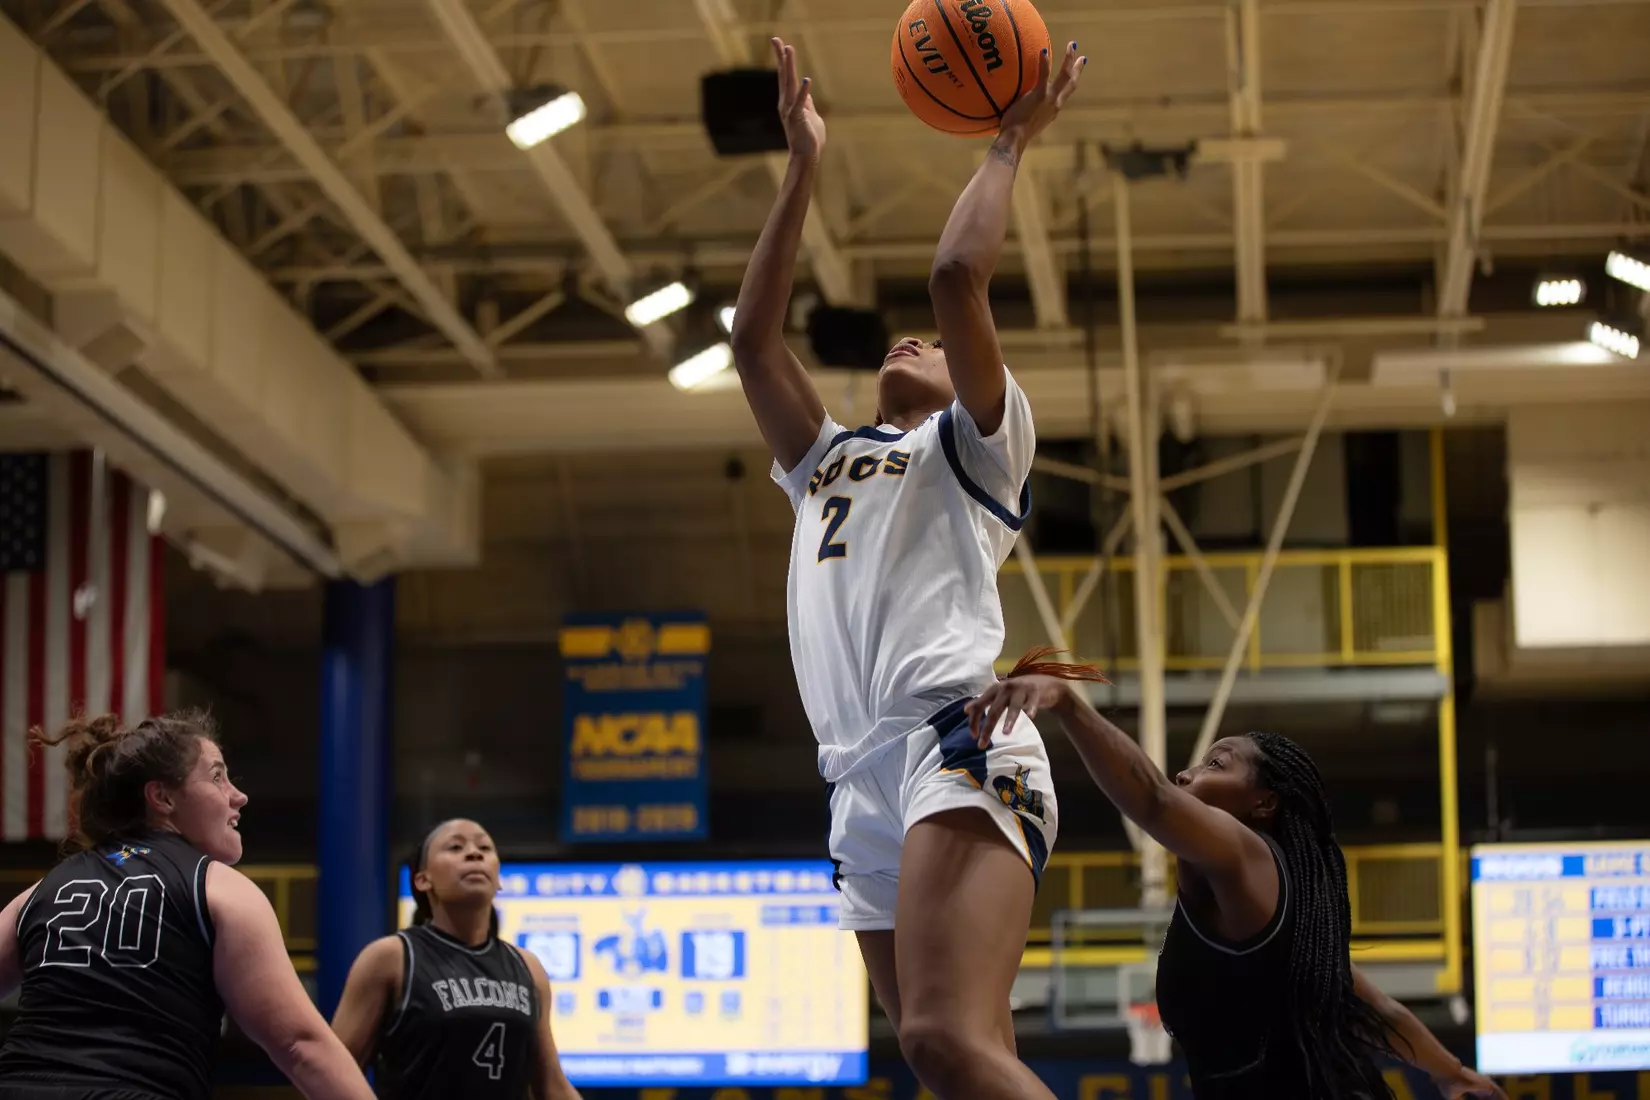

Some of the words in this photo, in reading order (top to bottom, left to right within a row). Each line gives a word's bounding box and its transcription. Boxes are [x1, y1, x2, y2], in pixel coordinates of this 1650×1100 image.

[908, 18, 949, 75] EVO
[960, 0, 1004, 73] ilson
[817, 494, 853, 566] 2
[571, 711, 701, 757] NCAA
[653, 871, 832, 894] BASKETBAL
[39, 873, 166, 969] 20
[431, 977, 531, 1016] FALCONS
[472, 1022, 506, 1080] 4
